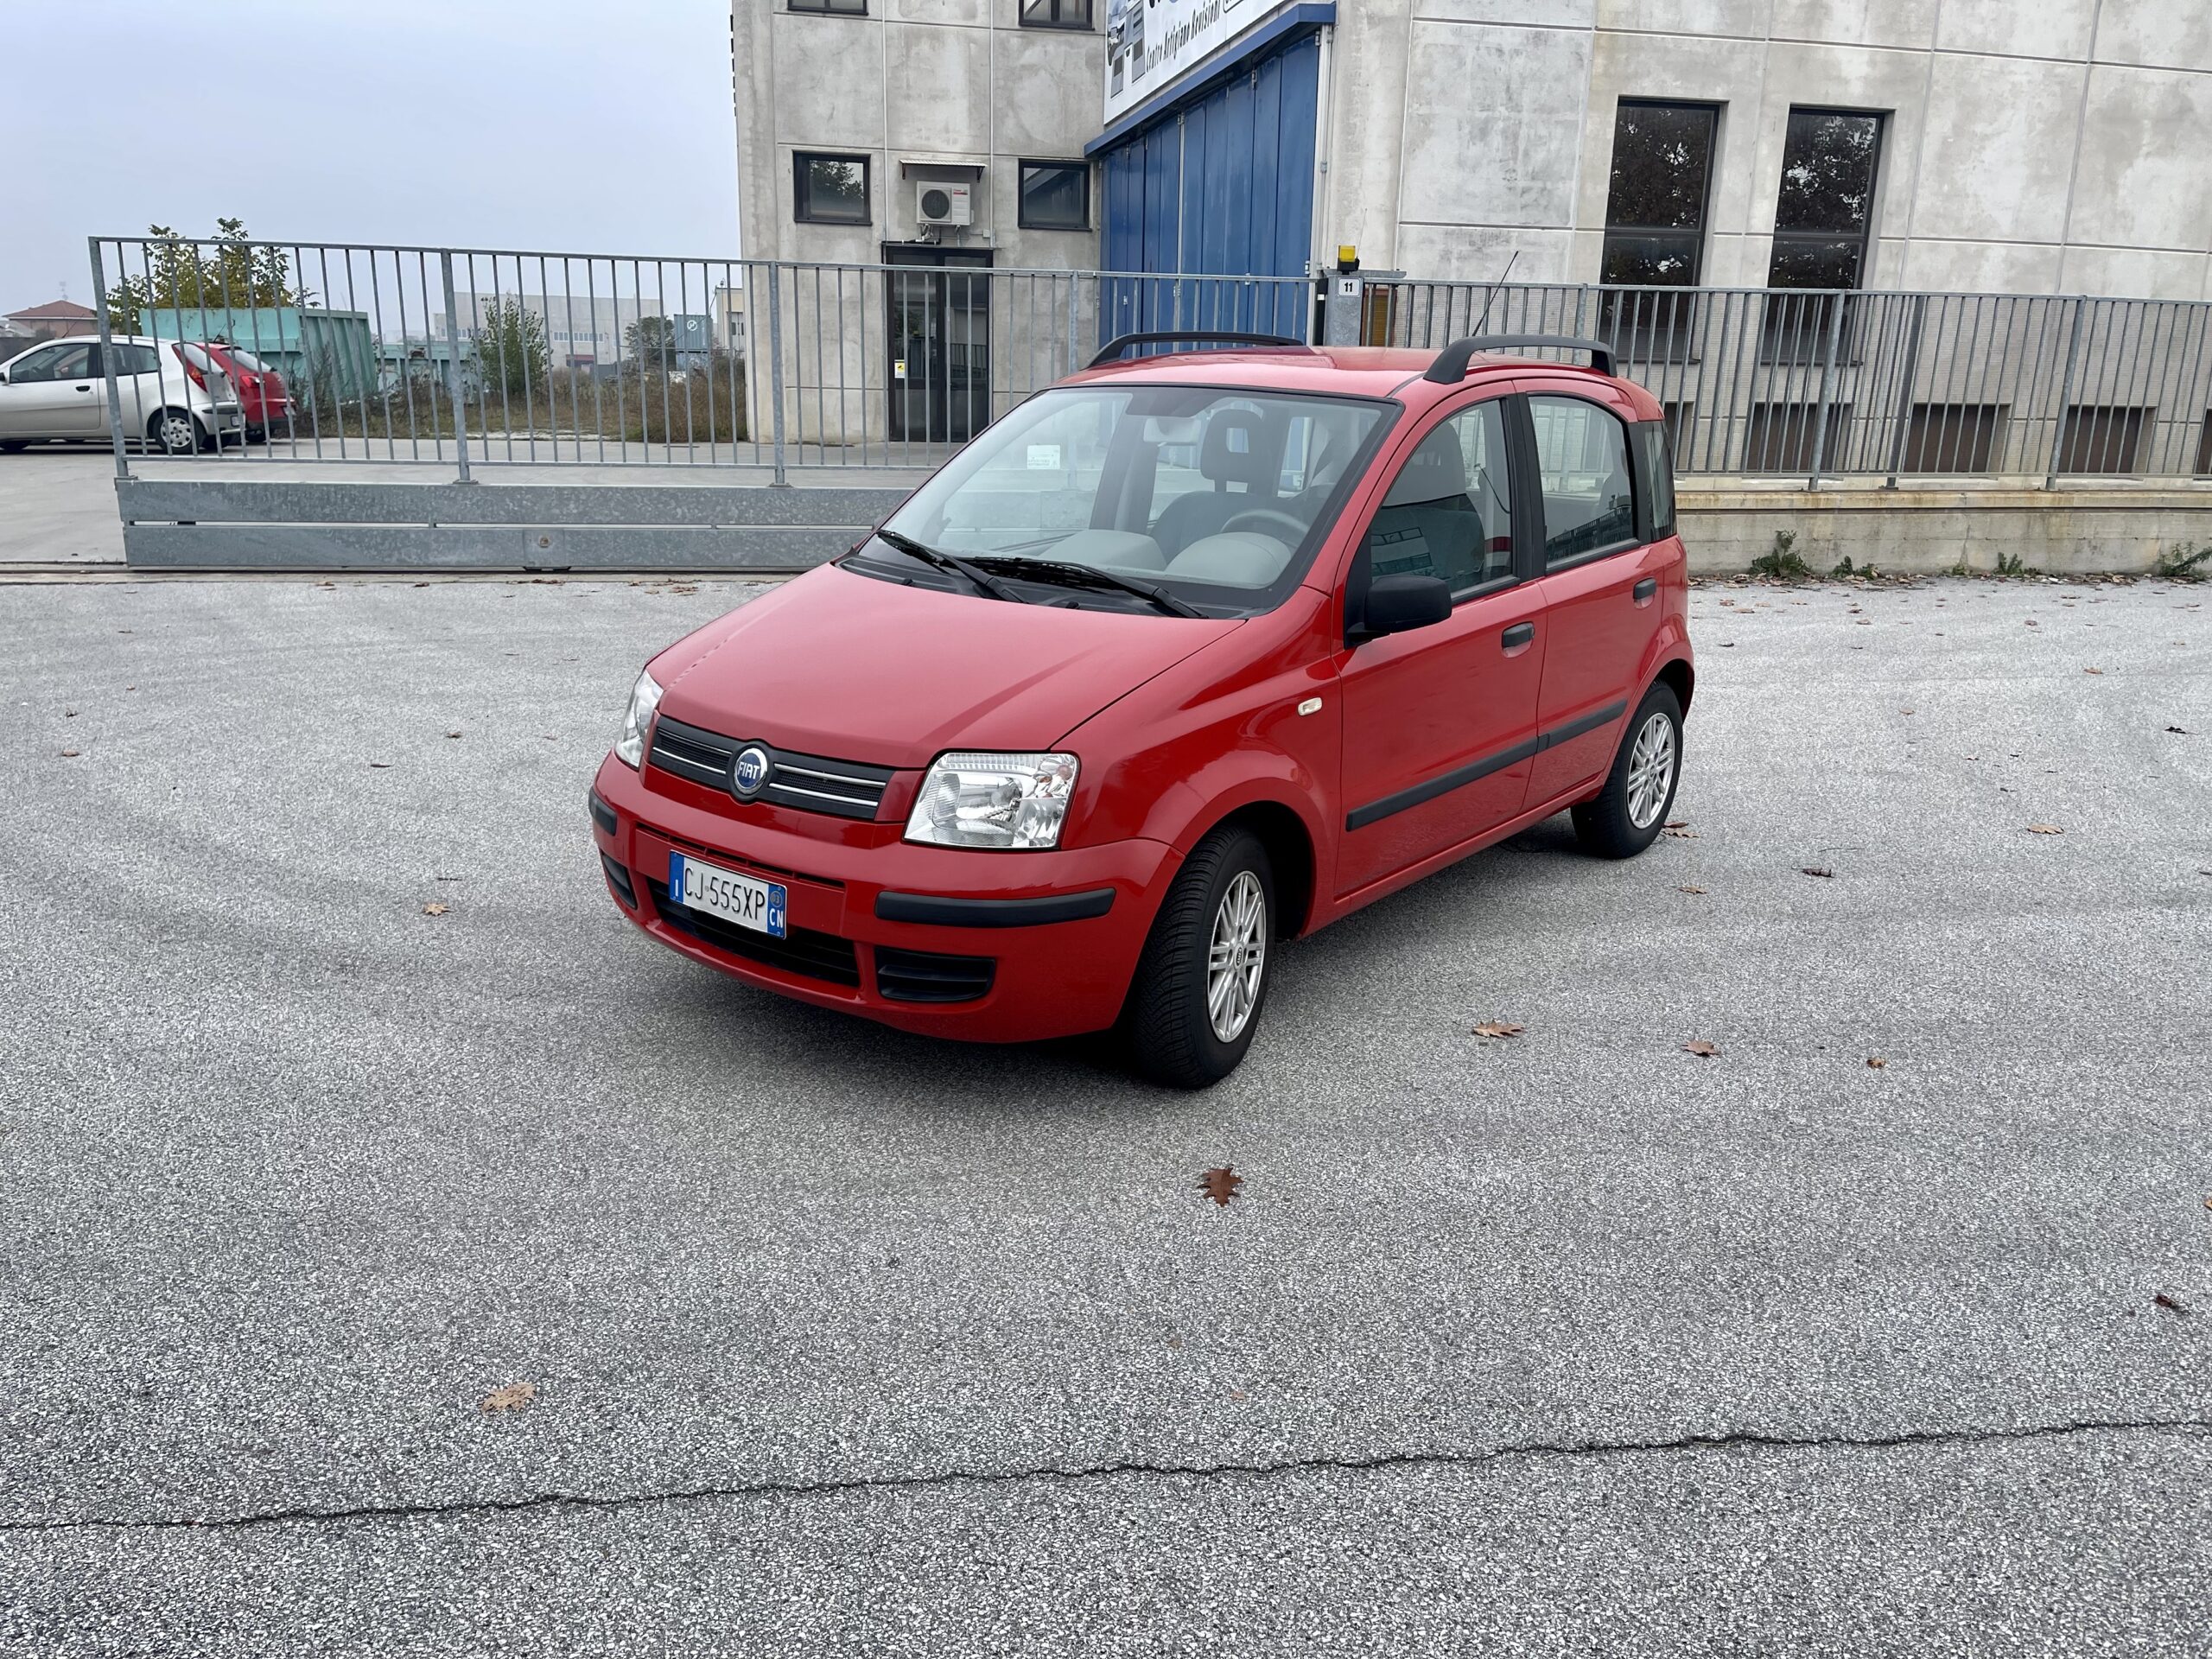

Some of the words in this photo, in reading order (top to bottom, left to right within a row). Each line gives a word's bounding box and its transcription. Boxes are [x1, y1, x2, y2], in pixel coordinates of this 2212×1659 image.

[1146, 41, 1163, 73] Centro
[1163, 21, 1190, 60] Artigiano
[1191, 0, 1221, 41] Revisioni
[1344, 282, 1353, 293] 11
[737, 760, 761, 780] FIAT
[769, 908, 784, 929] CN
